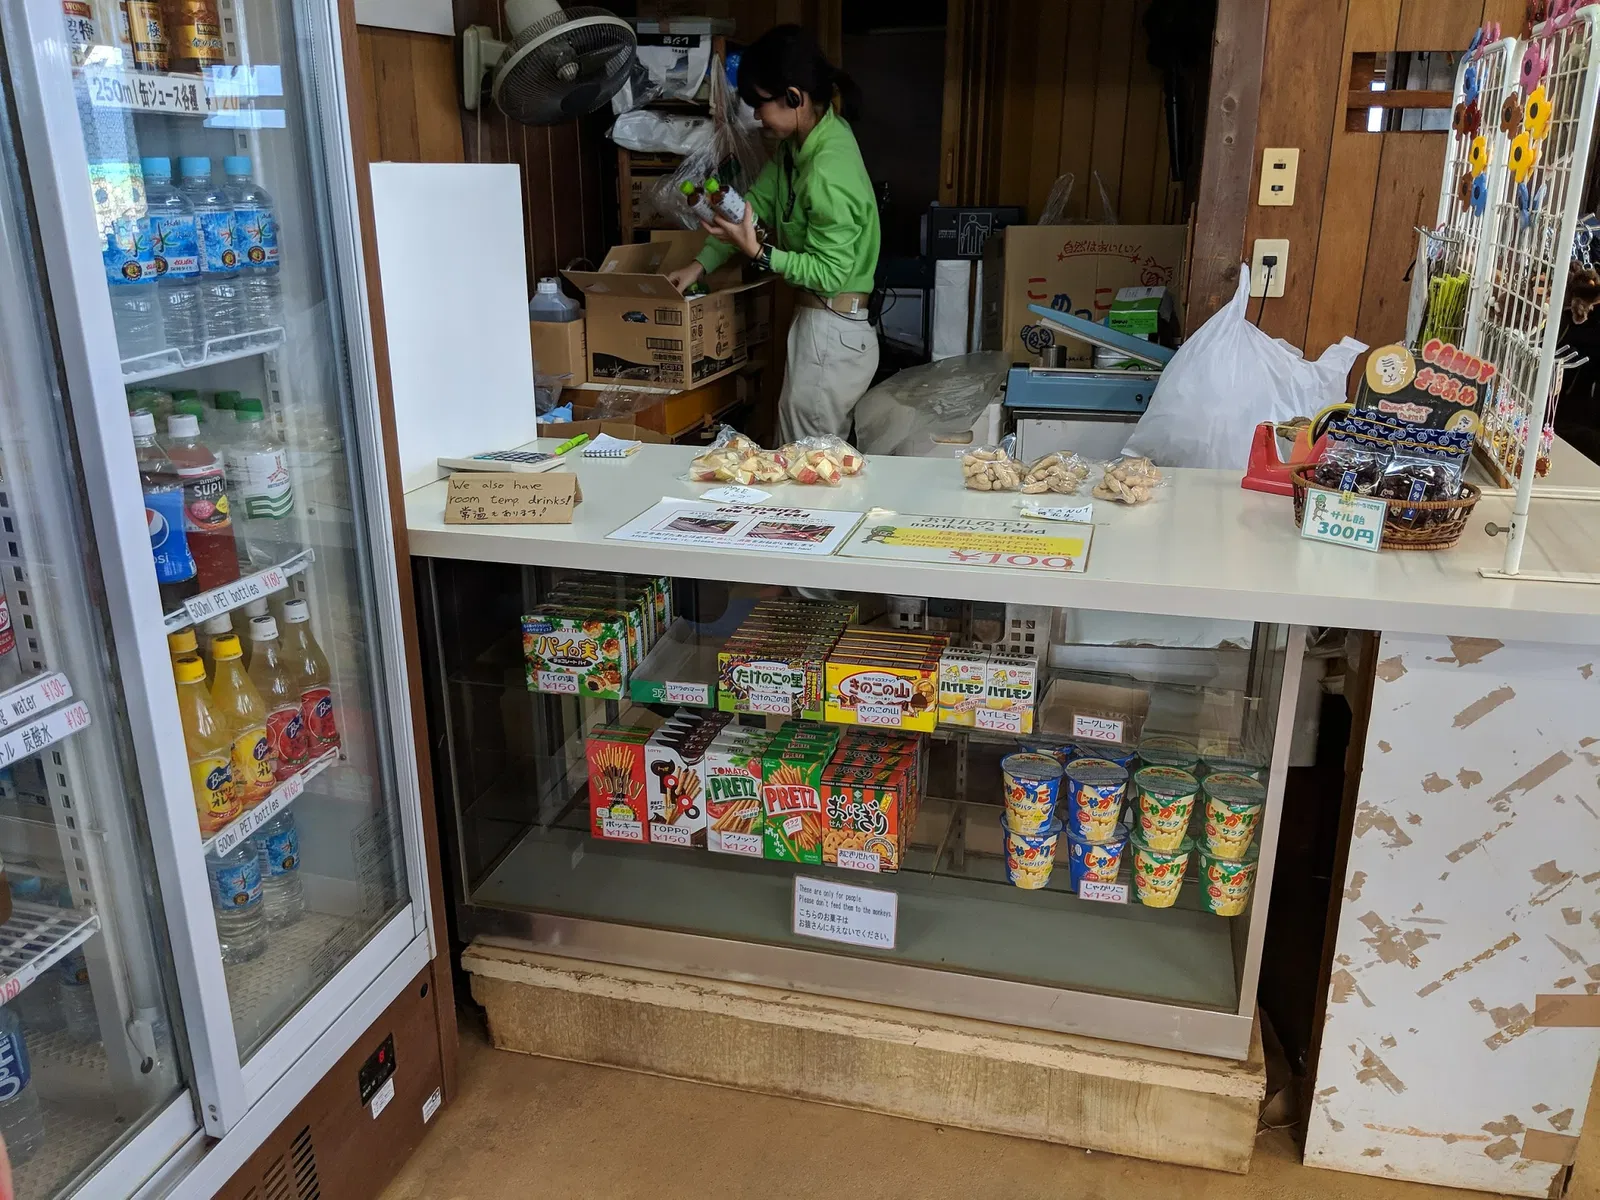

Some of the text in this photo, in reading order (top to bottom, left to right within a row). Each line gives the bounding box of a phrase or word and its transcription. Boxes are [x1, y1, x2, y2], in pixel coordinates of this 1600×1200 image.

[1423, 339, 1497, 384] CANDY
[1414, 367, 1478, 406] さるあめ
[452, 478, 544, 491] We also have
[449, 495, 480, 505] room
[528, 494, 572, 506] drinks!
[922, 517, 1031, 529] おサルのエサ
[1331, 511, 1365, 525] サル飴
[910, 522, 1046, 535] monkey's feed
[1318, 522, 1374, 544] 300円
[949, 551, 1075, 570] ¥100
[188, 598, 214, 619] 500ml
[214, 591, 230, 608] PET
[229, 582, 260, 602] bottles
[538, 636, 599, 660] パイの実
[542, 674, 575, 684] パイの実
[736, 668, 803, 688] たけのこの里
[543, 682, 577, 692] ¥150
[668, 684, 706, 693] コアラのマーチ
[849, 679, 910, 698] きのこの山
[941, 681, 984, 694] ハイレモン
[987, 686, 1032, 700] ハイレモン
[669, 693, 704, 703] ¥100
[751, 693, 790, 703] たけのこの里
[11, 694, 37, 716] water
[752, 702, 791, 713] ¥200
[860, 705, 899, 715] きのこの山
[861, 715, 900, 725] ¥200
[976, 710, 1020, 721] ハイレモン
[978, 718, 1016, 731] ¥120
[1077, 717, 1120, 730] ヨーグレット
[22, 722, 53, 753] 炭酸水
[1076, 727, 1116, 740] ¥120
[711, 767, 749, 776] TOMATO
[592, 773, 645, 800] POCKY
[711, 777, 757, 800] PRETZ
[765, 787, 818, 812] PRETZ
[827, 795, 888, 836] おにぎり
[217, 831, 238, 853] 500ml
[239, 821, 253, 837] PET
[254, 799, 280, 823] bottles
[606, 820, 641, 830] ポッキー
[652, 825, 689, 835] TOPPO
[829, 820, 858, 829] せんべい
[1157, 819, 1180, 828] サラダ
[606, 828, 639, 839] ¥150
[653, 834, 687, 844] ¥150
[1222, 828, 1246, 837] サラダ
[724, 842, 757, 853] ¥120
[840, 860, 875, 871] ¥100
[1085, 884, 1124, 893] じゃがりこ
[1151, 878, 1174, 887] サラダ
[799, 883, 812, 894] These
[814, 888, 822, 896] are
[823, 890, 834, 900] only
[1084, 891, 1122, 902] ¥150
[798, 894, 814, 905] Please
[816, 898, 829, 908] don't
[830, 900, 842, 910] feed
[843, 902, 854, 912] them
[855, 905, 861, 913] to
[862, 906, 871, 915] the
[799, 908, 848, 925] こちらのお菓子は
